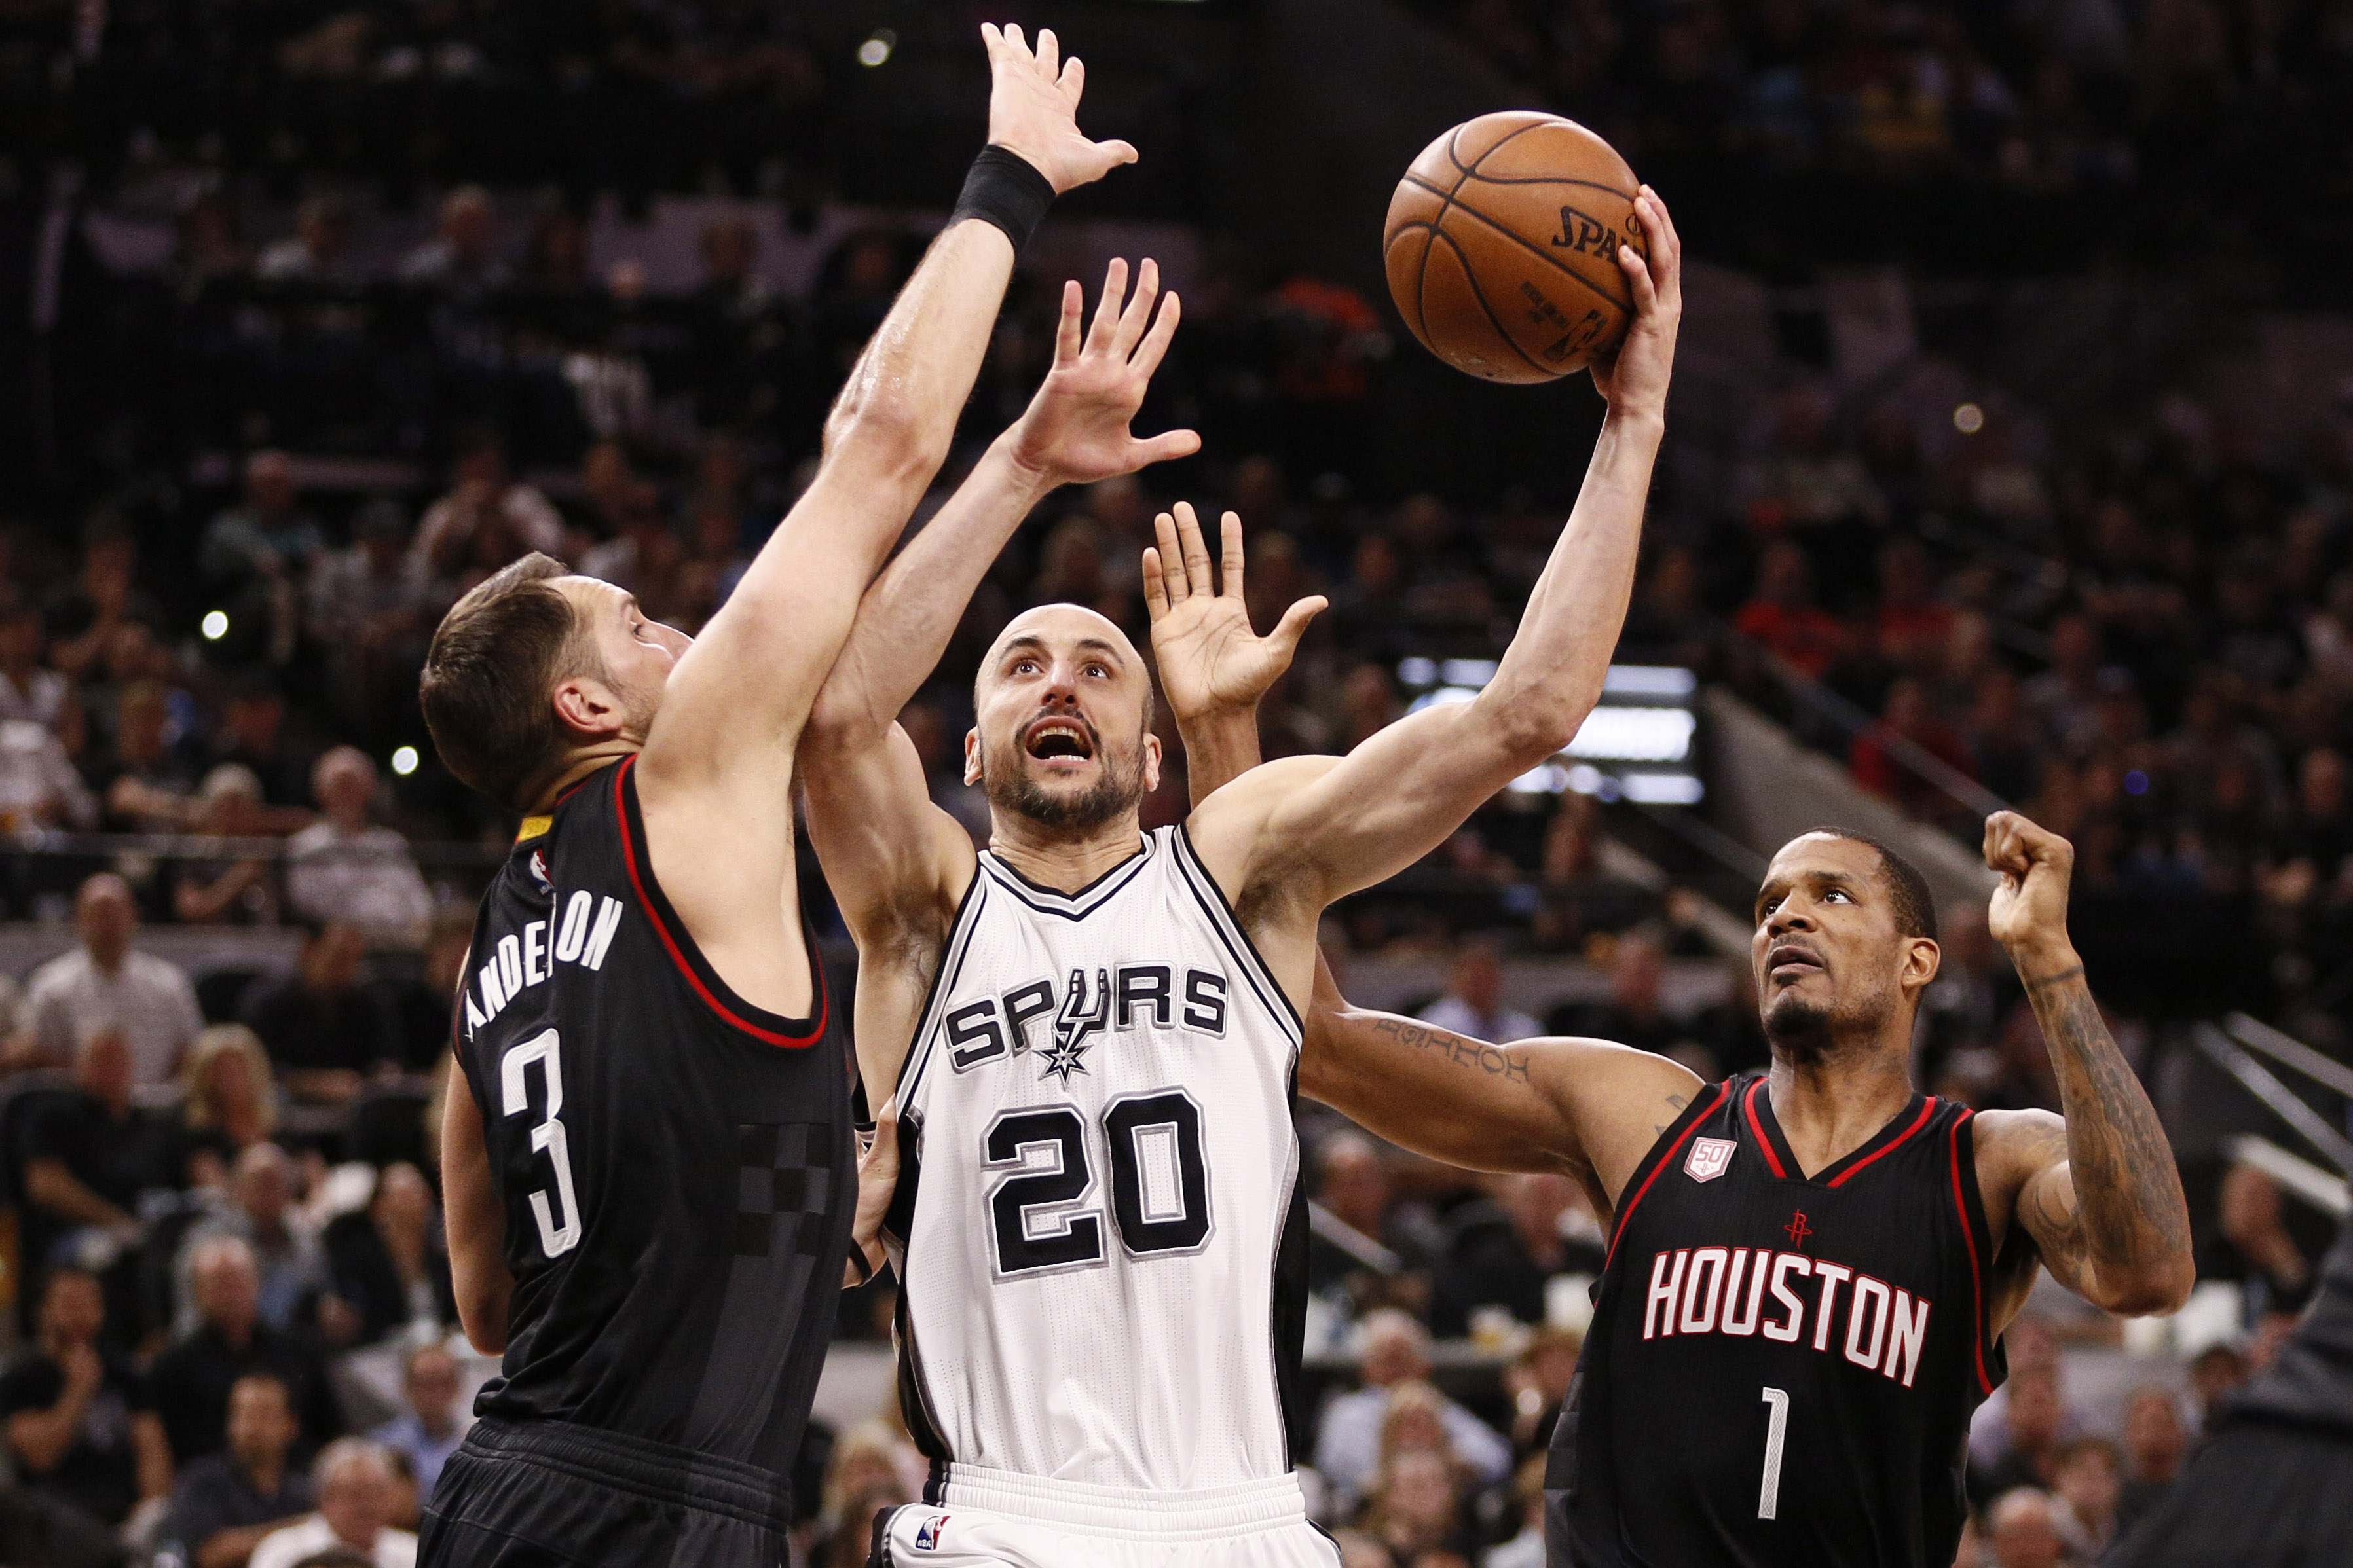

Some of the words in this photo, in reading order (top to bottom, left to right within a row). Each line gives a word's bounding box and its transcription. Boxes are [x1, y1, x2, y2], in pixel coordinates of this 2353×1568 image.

[1552, 206, 1644, 263] SPA
[465, 890, 623, 1042] ANDEON
[942, 960, 1229, 1074] SPURS
[502, 1028, 582, 1258] 3
[980, 1085, 1216, 1284] 20
[1695, 1144, 1726, 1163] 50
[1643, 1246, 1931, 1389] HOUSTON
[1758, 1387, 1789, 1520] 1
[917, 1539, 932, 1548] NBA
